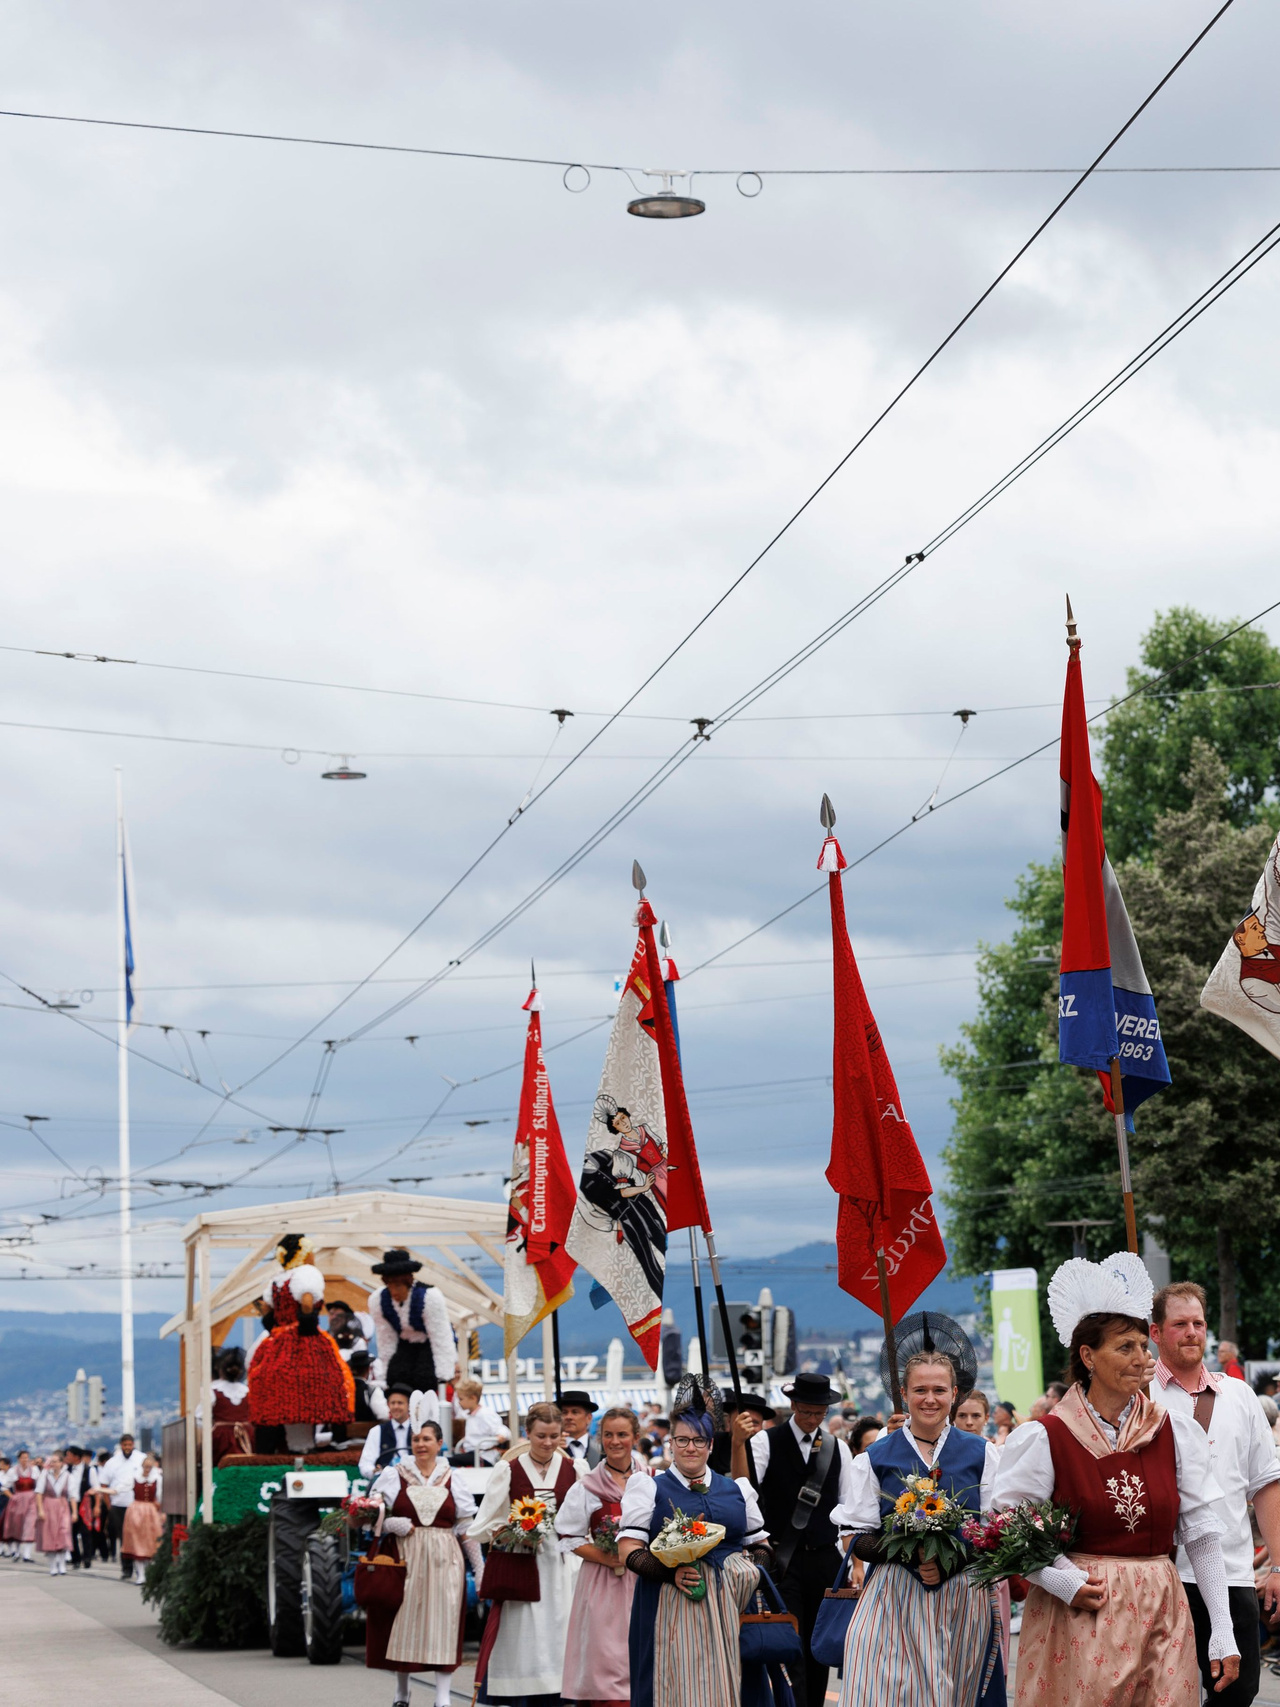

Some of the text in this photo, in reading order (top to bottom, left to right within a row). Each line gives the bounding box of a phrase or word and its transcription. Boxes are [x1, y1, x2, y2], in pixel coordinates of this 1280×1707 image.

[1114, 1011, 1161, 1041] VEREI
[1118, 1041, 1154, 1061] 1963
[531, 1136, 550, 1235] Trachtengruppe
